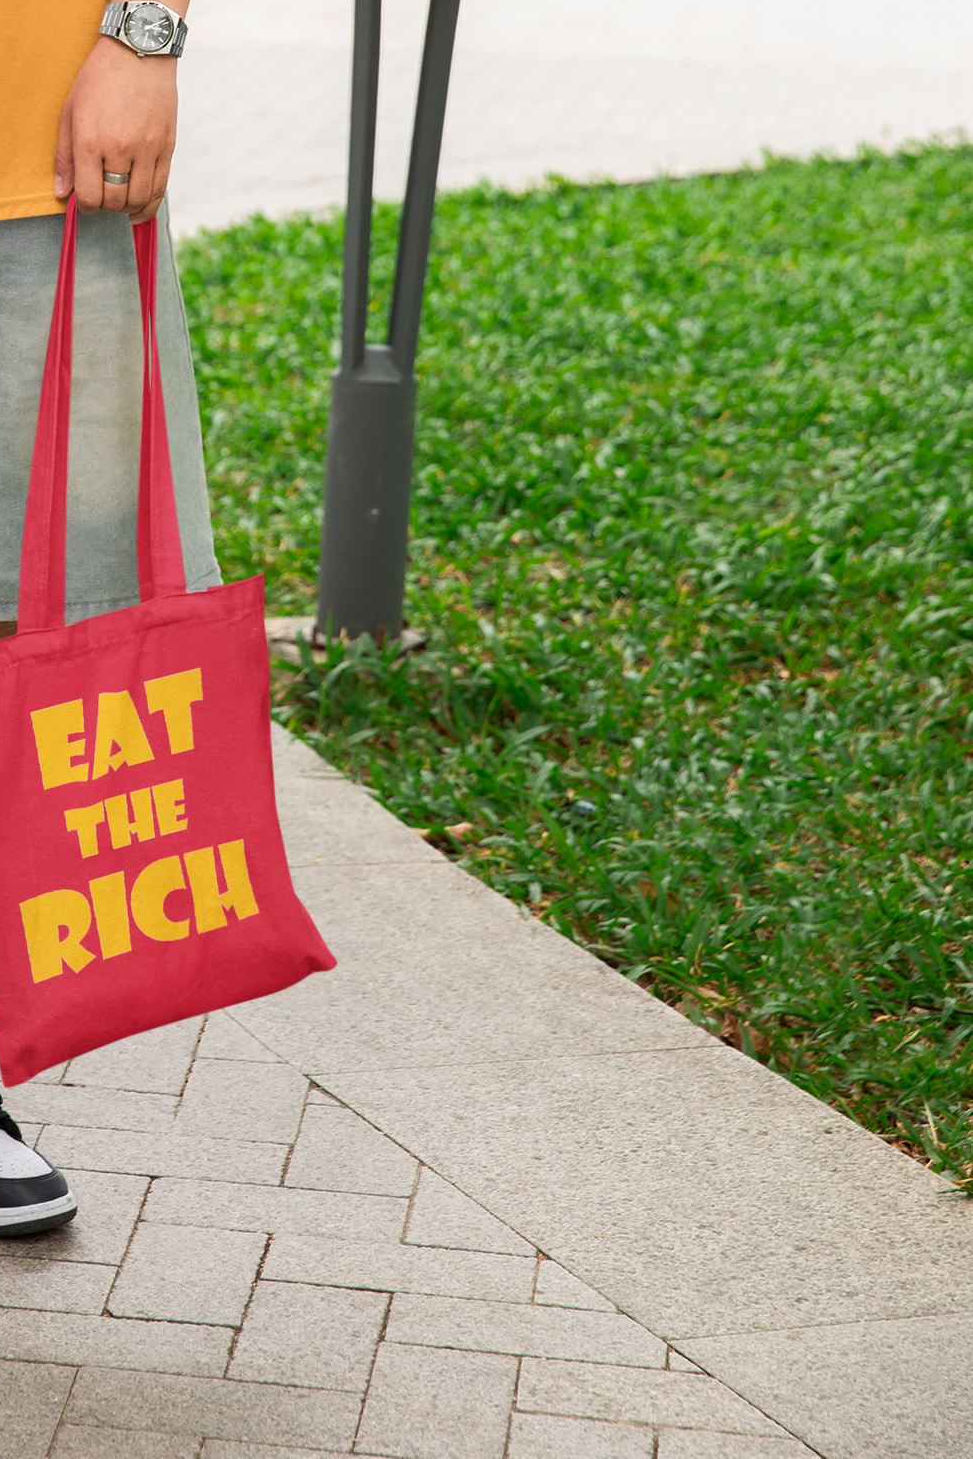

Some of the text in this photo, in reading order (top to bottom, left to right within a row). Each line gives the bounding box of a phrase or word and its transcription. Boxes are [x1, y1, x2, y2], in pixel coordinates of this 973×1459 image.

[30, 668, 204, 791] EAT
[64, 778, 189, 859] THE
[18, 838, 260, 984] RICH
